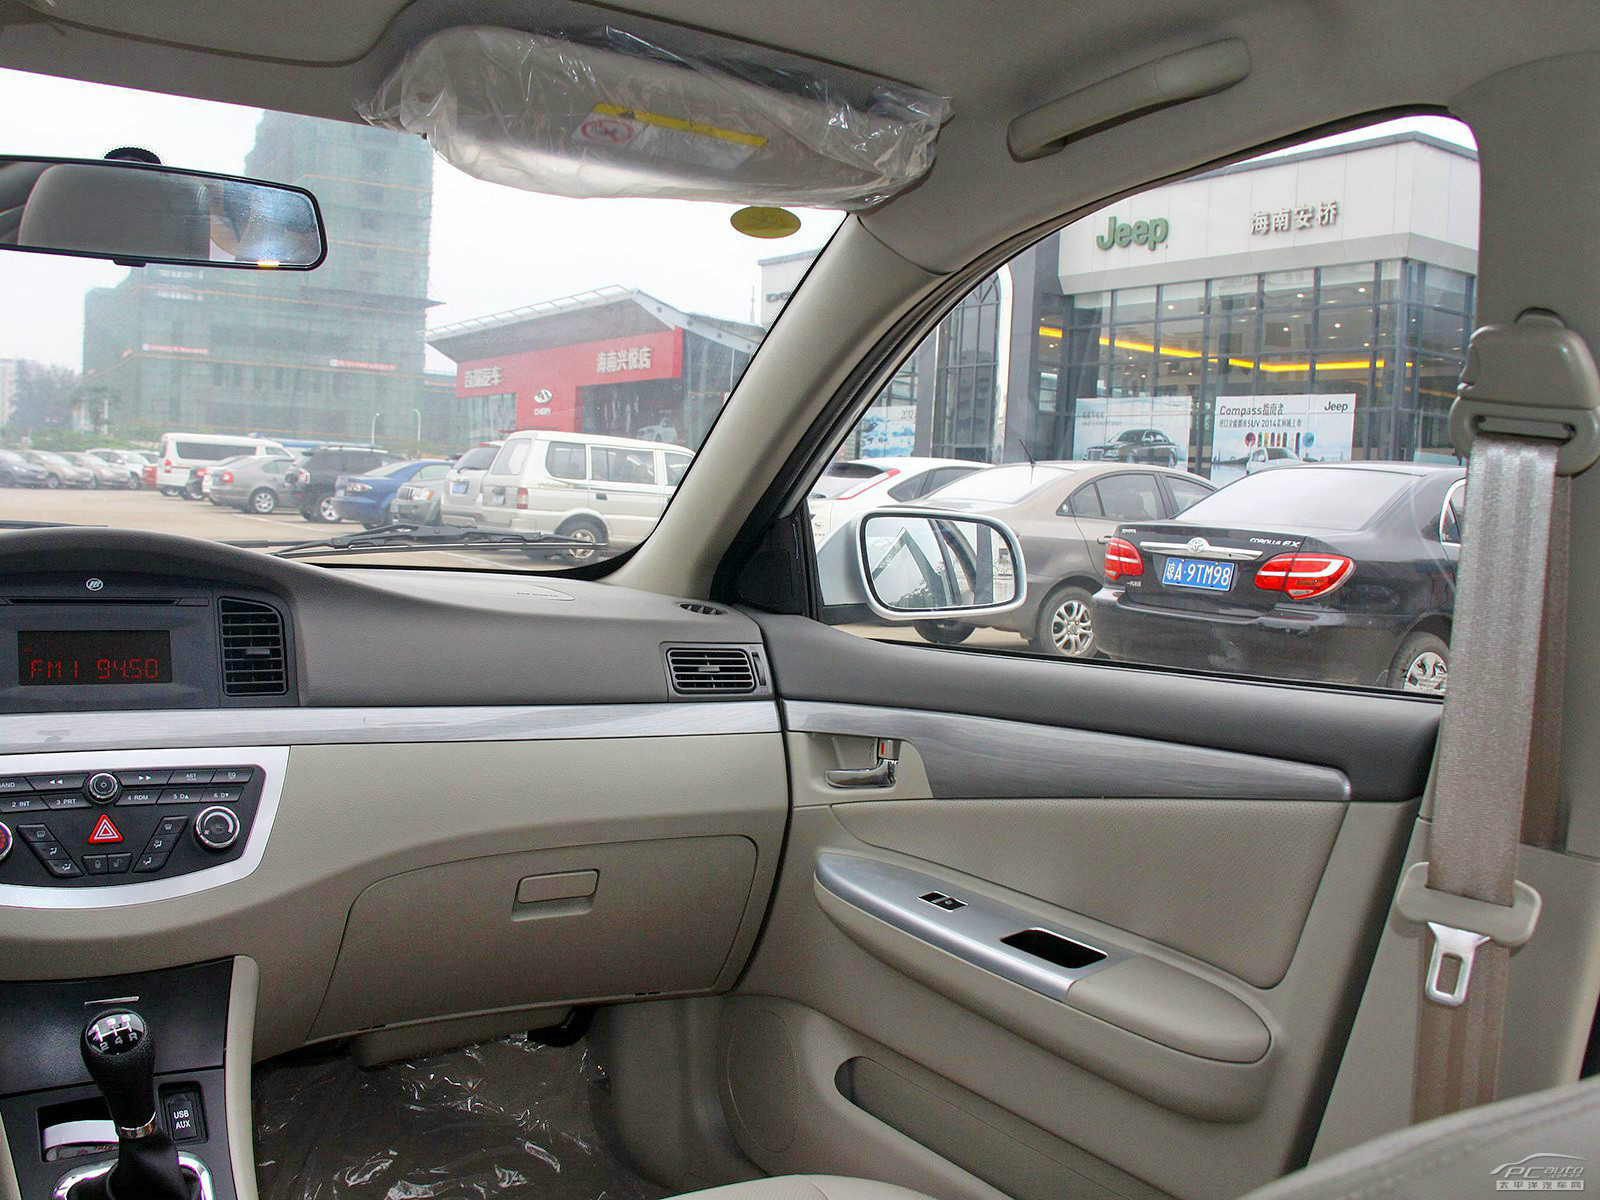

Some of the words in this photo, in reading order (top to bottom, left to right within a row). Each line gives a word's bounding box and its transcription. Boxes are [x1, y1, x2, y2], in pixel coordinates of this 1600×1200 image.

[1251, 201, 1338, 235] 海南安桥
[1096, 216, 1169, 251] Jeep
[1324, 401, 1348, 413] Jeep
[19, 800, 31, 808] INT
[63, 798, 77, 806] PRT
[100, 1041, 109, 1051] 2
[115, 1036, 123, 1045] 4
[129, 1032, 138, 1042] R
[173, 1110, 190, 1120] USB
[176, 1120, 191, 1130] AUX
